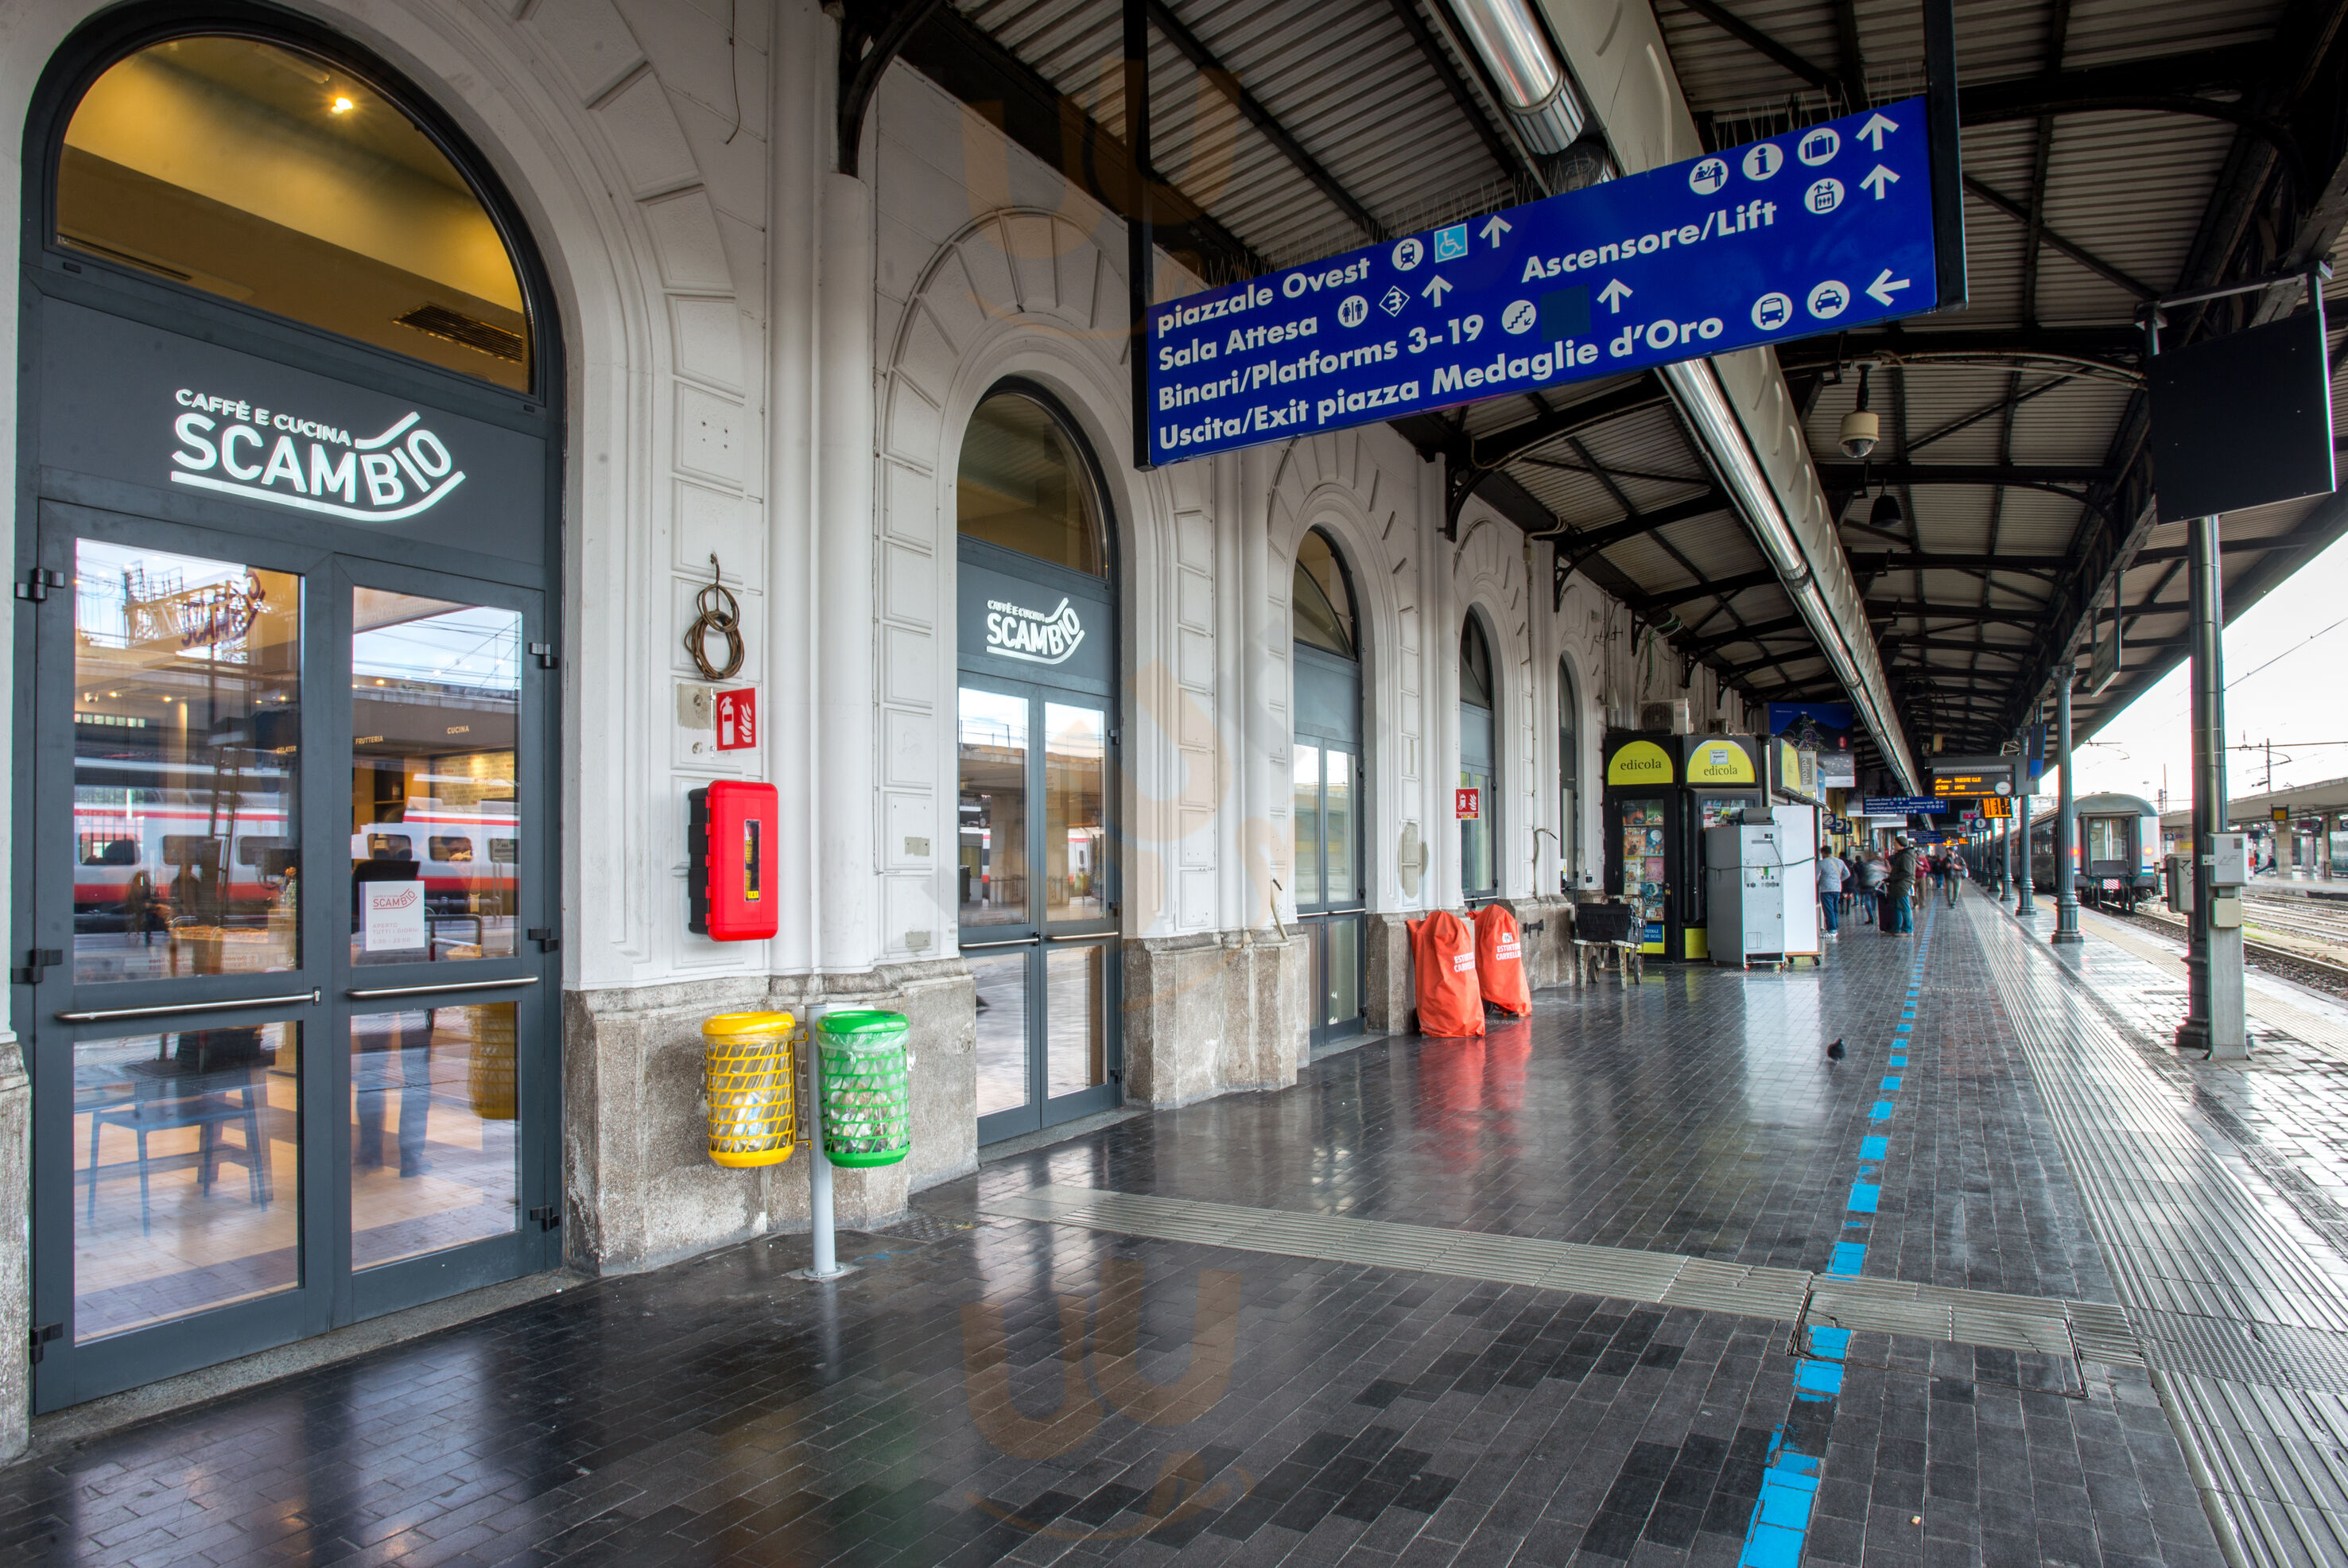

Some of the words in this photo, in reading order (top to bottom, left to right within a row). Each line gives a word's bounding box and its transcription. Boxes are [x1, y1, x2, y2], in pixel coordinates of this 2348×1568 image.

[1521, 199, 1778, 283] Ascensore/Lift
[1158, 283, 1274, 339] piazzale
[1282, 257, 1371, 298] Ovest
[1158, 338, 1217, 371] Sala
[1224, 316, 1318, 355] Attesa
[1158, 340, 1399, 412] Binari/Platforms
[1407, 314, 1484, 354] 3-19
[1159, 398, 1310, 450] Uscita/Exit
[1317, 380, 1420, 425] piazza
[1431, 340, 1600, 396] Medaglie
[1609, 317, 1725, 358] d'Oro
[175, 389, 250, 421] CAFFÈ
[254, 408, 270, 426] E
[274, 413, 352, 447] CUCINA
[172, 412, 452, 506] SCAMBIO
[986, 607, 1081, 655] SCAMBIO
[355, 735, 383, 745] FRUTTERIA
[447, 725, 470, 735] CUCINA
[1620, 759, 1662, 770] edicola
[1703, 764, 1738, 776] edicola
[1801, 758, 1810, 784] edicola
[373, 891, 416, 907] SCAMBIO
